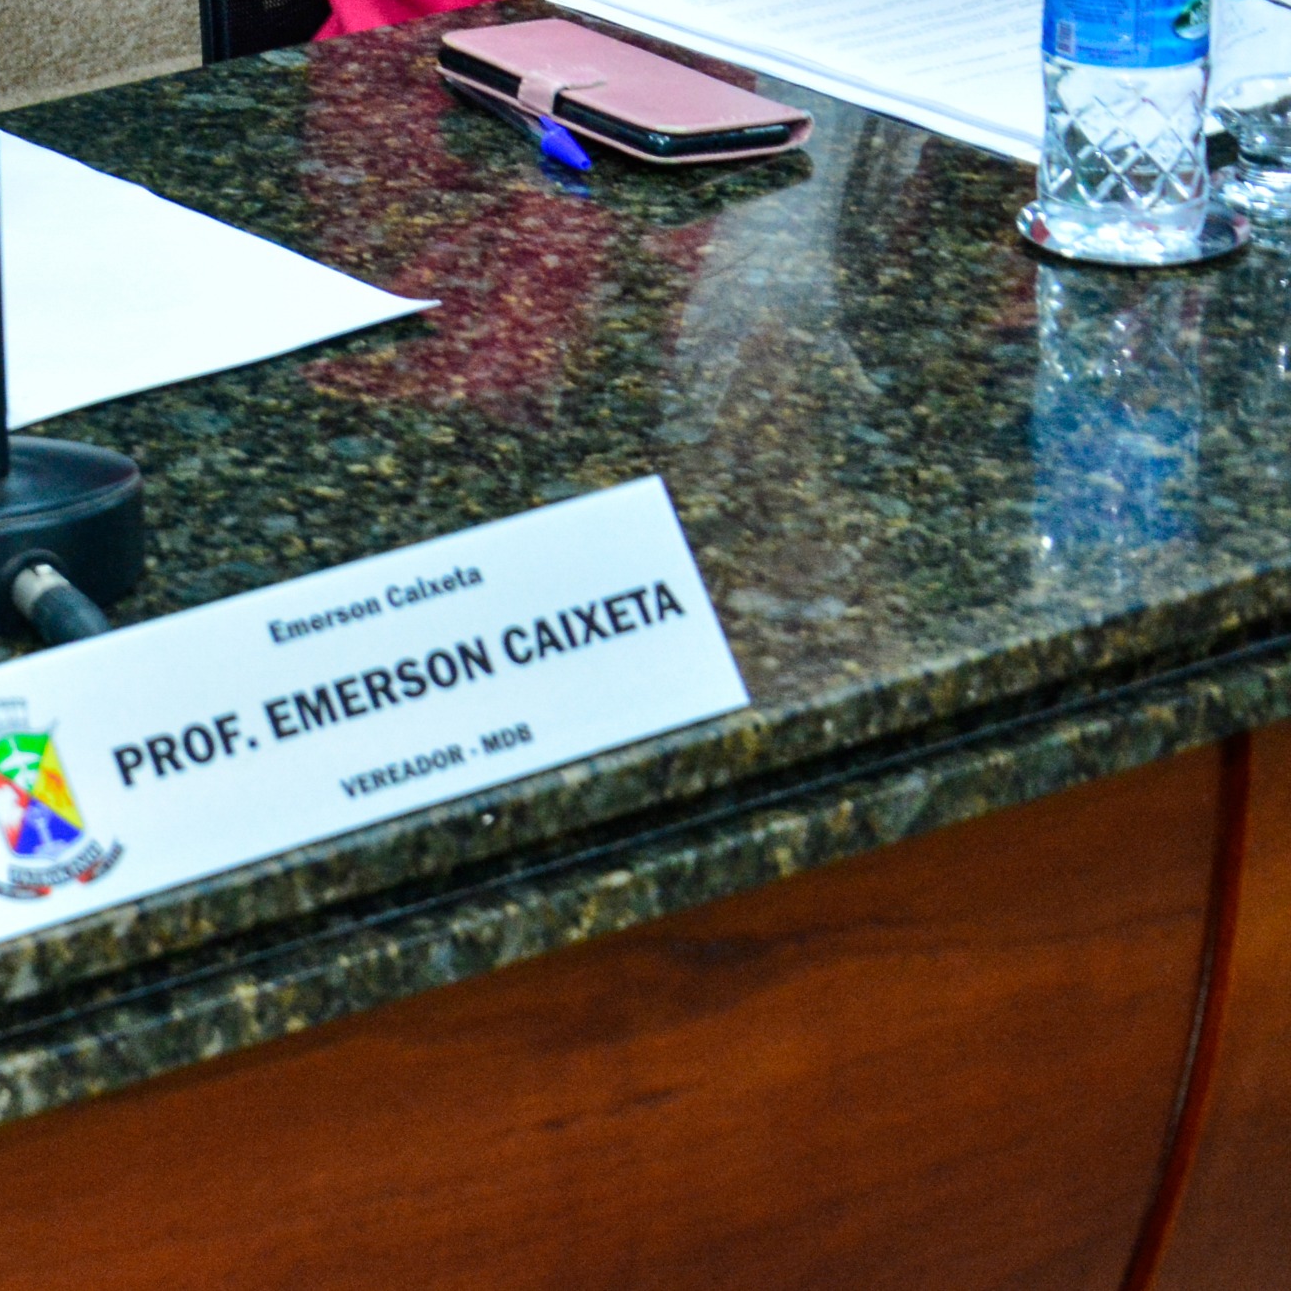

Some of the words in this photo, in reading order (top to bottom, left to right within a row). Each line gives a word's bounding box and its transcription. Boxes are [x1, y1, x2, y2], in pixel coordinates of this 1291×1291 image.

[268, 596, 382, 643] Emerson
[386, 566, 483, 608] Caixeta
[112, 713, 259, 787] PROF.
[263, 637, 494, 740] EMERSON
[502, 580, 685, 665] CAIXETA
[340, 743, 466, 798] VEREADOR
[481, 721, 534, 754] MDB
